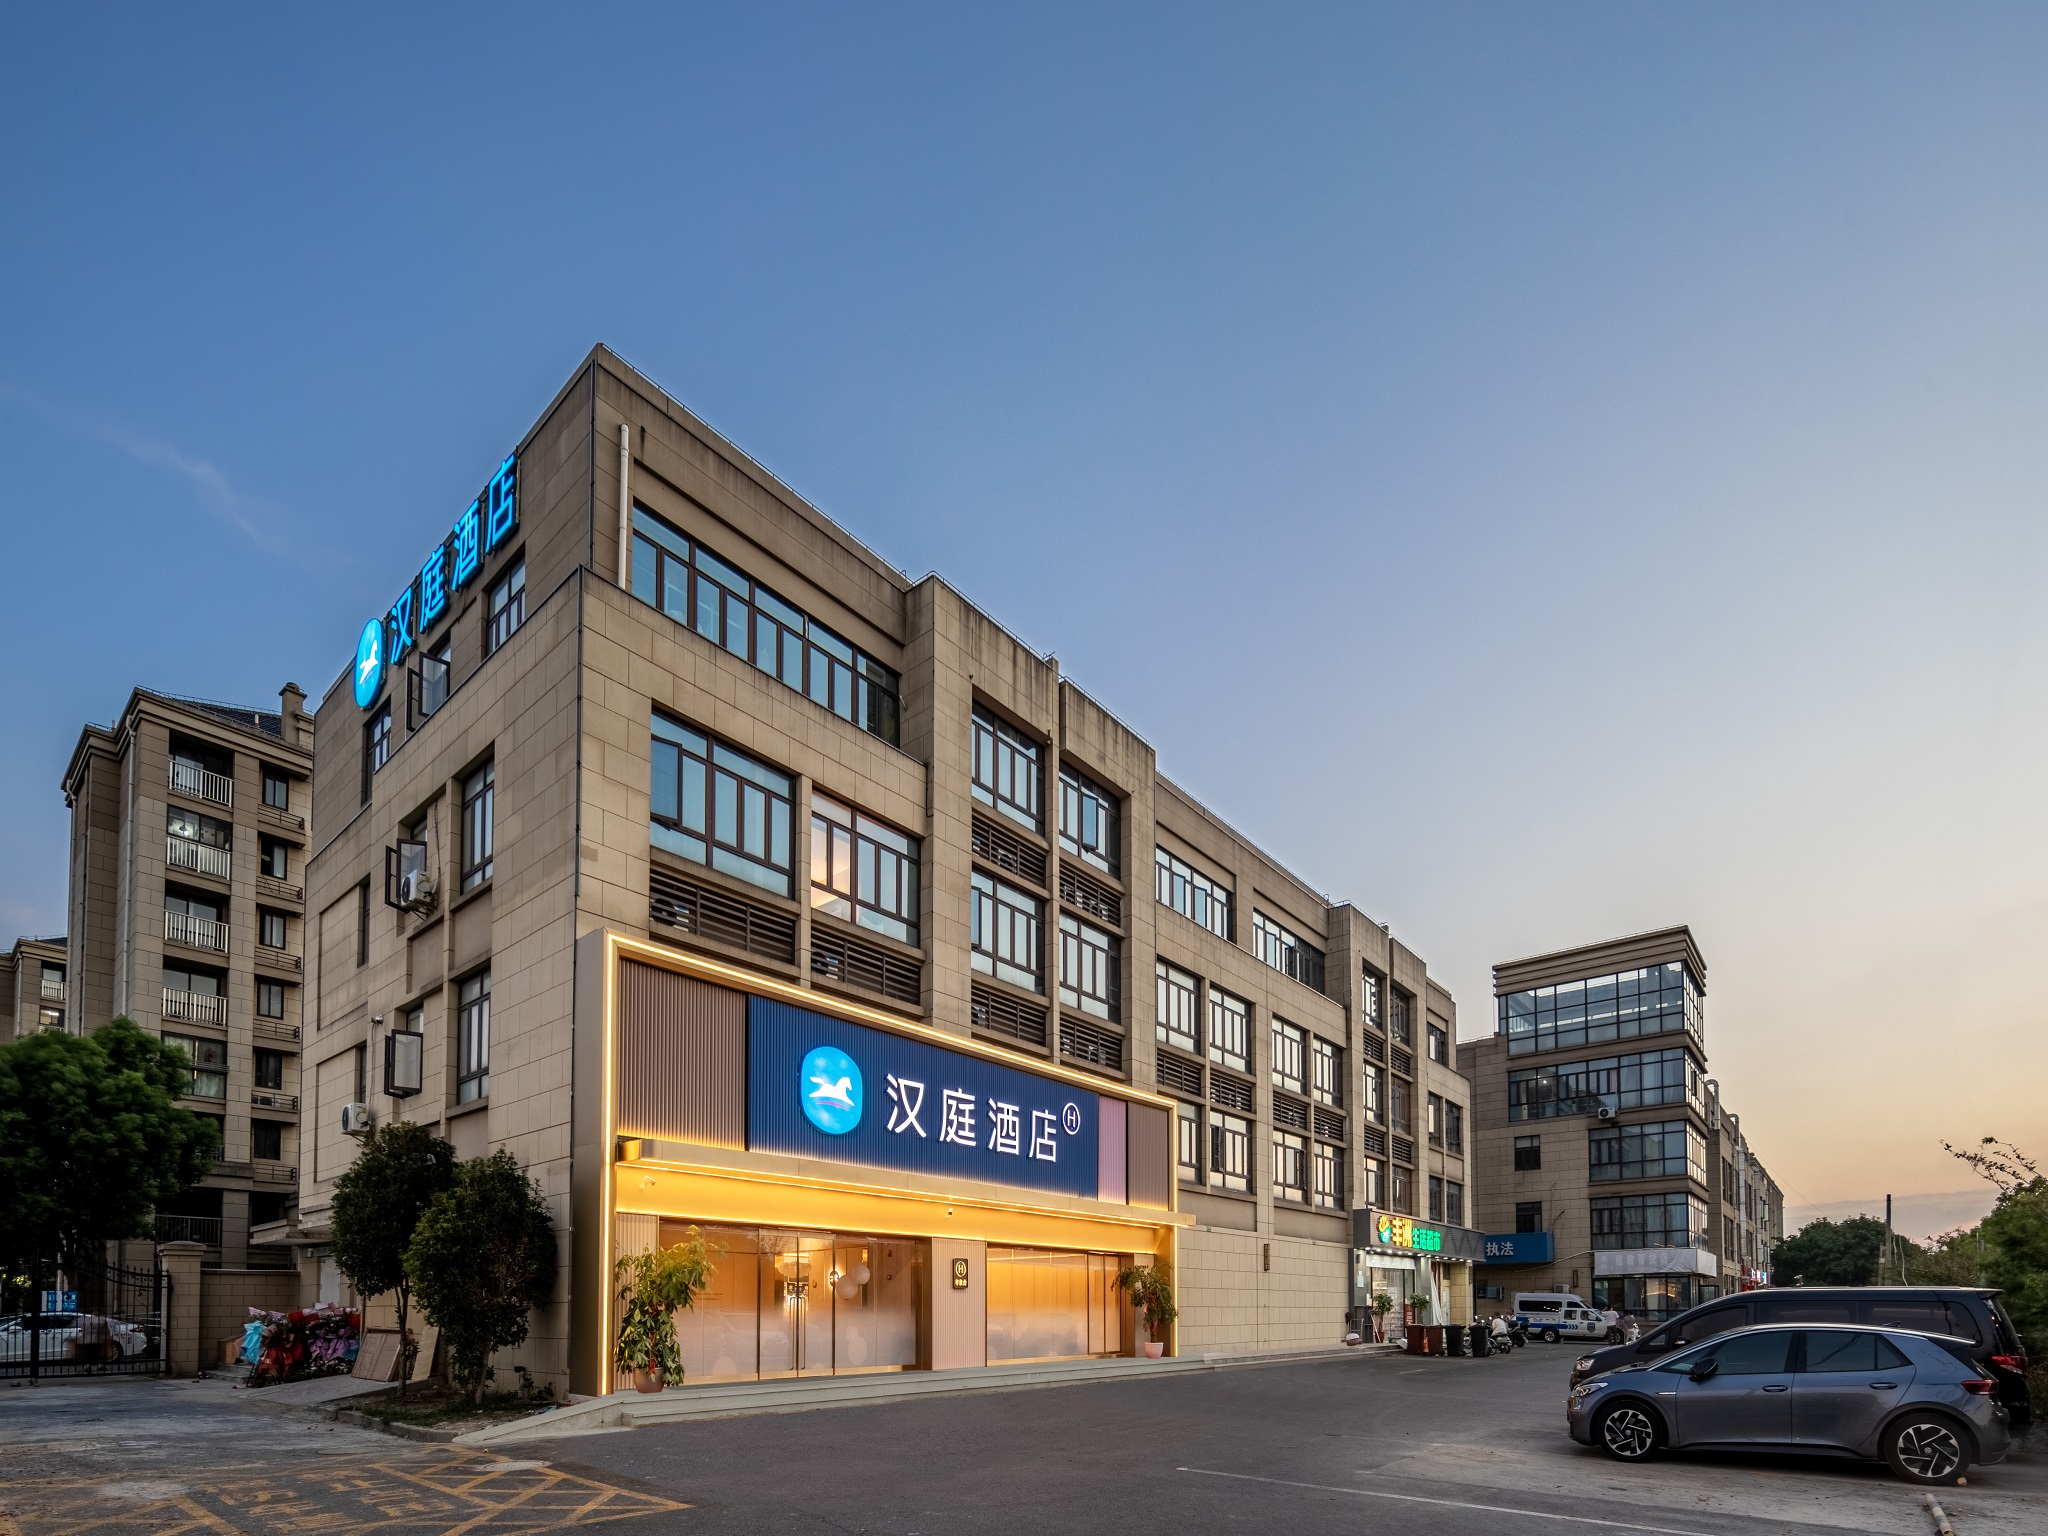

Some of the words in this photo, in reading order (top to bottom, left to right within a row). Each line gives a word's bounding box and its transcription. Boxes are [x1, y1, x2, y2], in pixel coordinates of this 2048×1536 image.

[390, 453, 516, 665] 汉庭酒店
[885, 1072, 1057, 1162] 汉庭酒店
[1485, 1241, 1514, 1256] 执法
